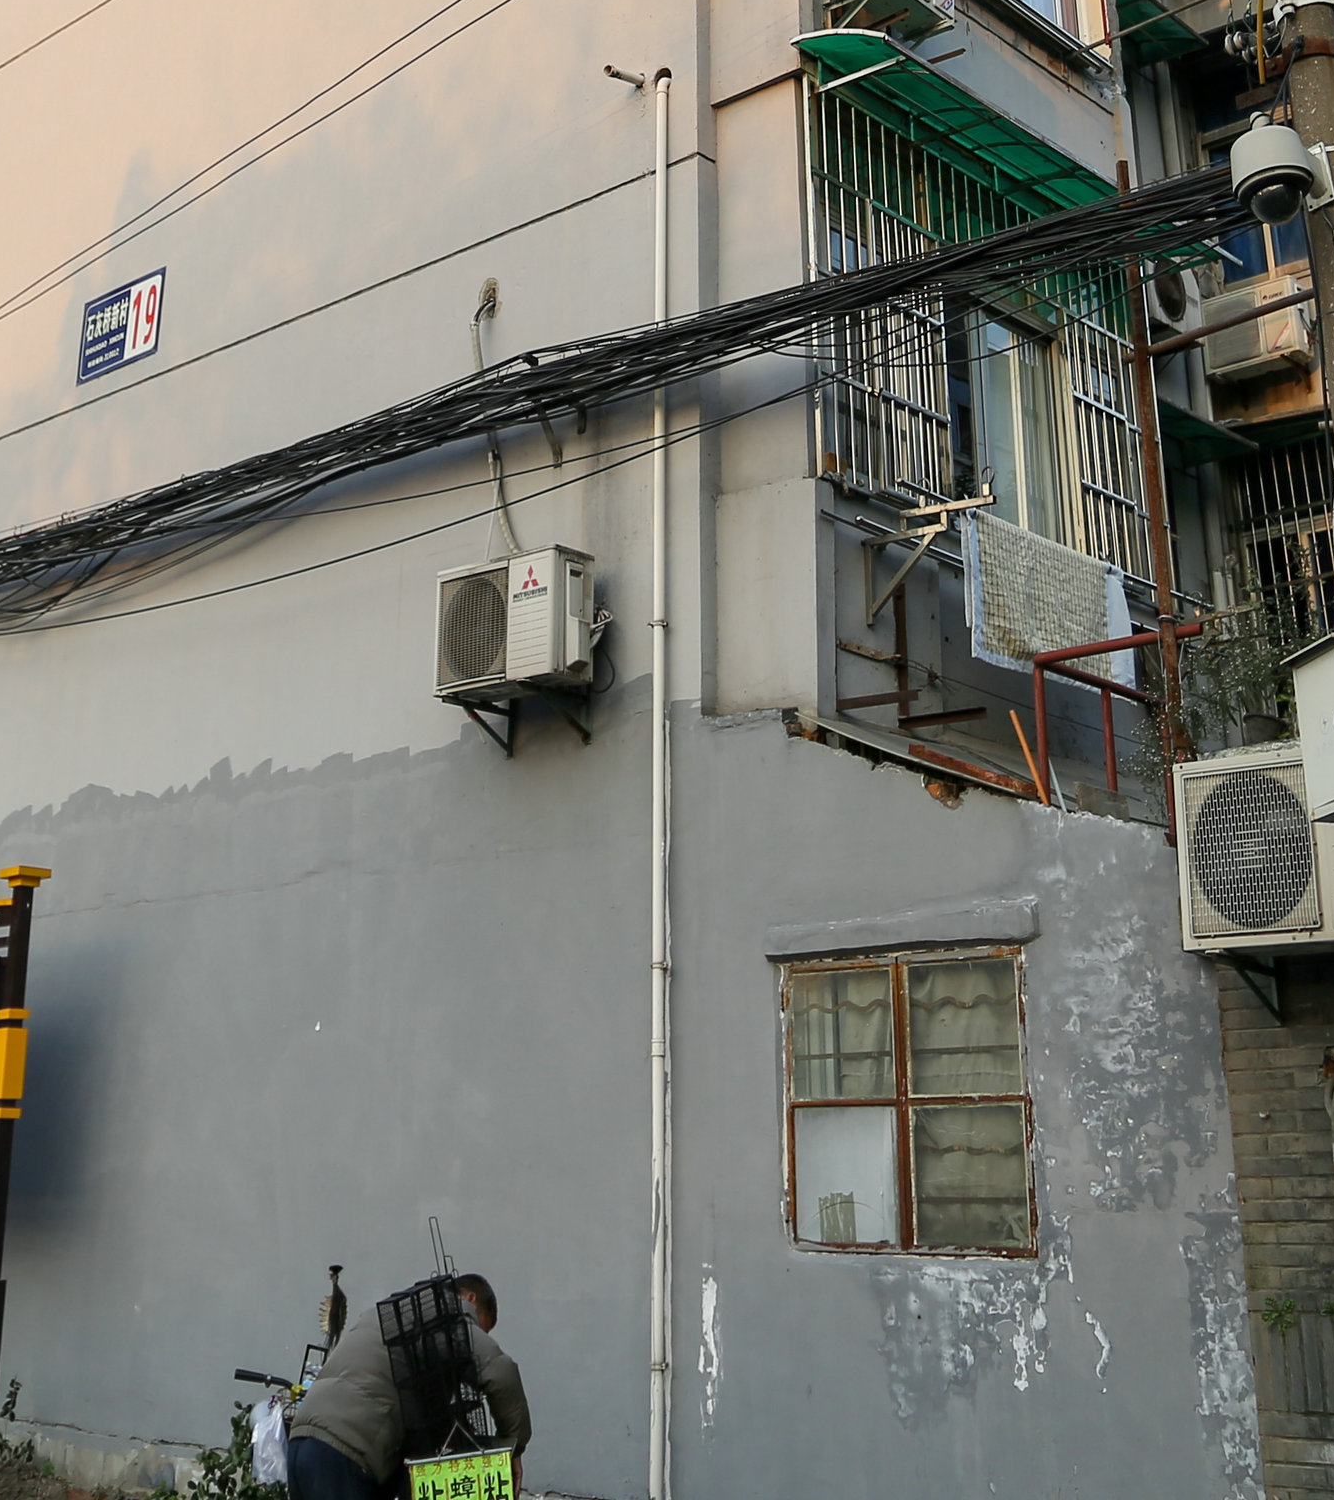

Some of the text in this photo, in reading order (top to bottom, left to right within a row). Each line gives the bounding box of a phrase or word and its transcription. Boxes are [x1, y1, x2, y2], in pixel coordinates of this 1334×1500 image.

[86, 297, 129, 341] 石灰桥新村
[132, 284, 158, 350] 19
[512, 585, 548, 599] MITSUBISHI
[450, 1474, 476, 1500] 蟑
